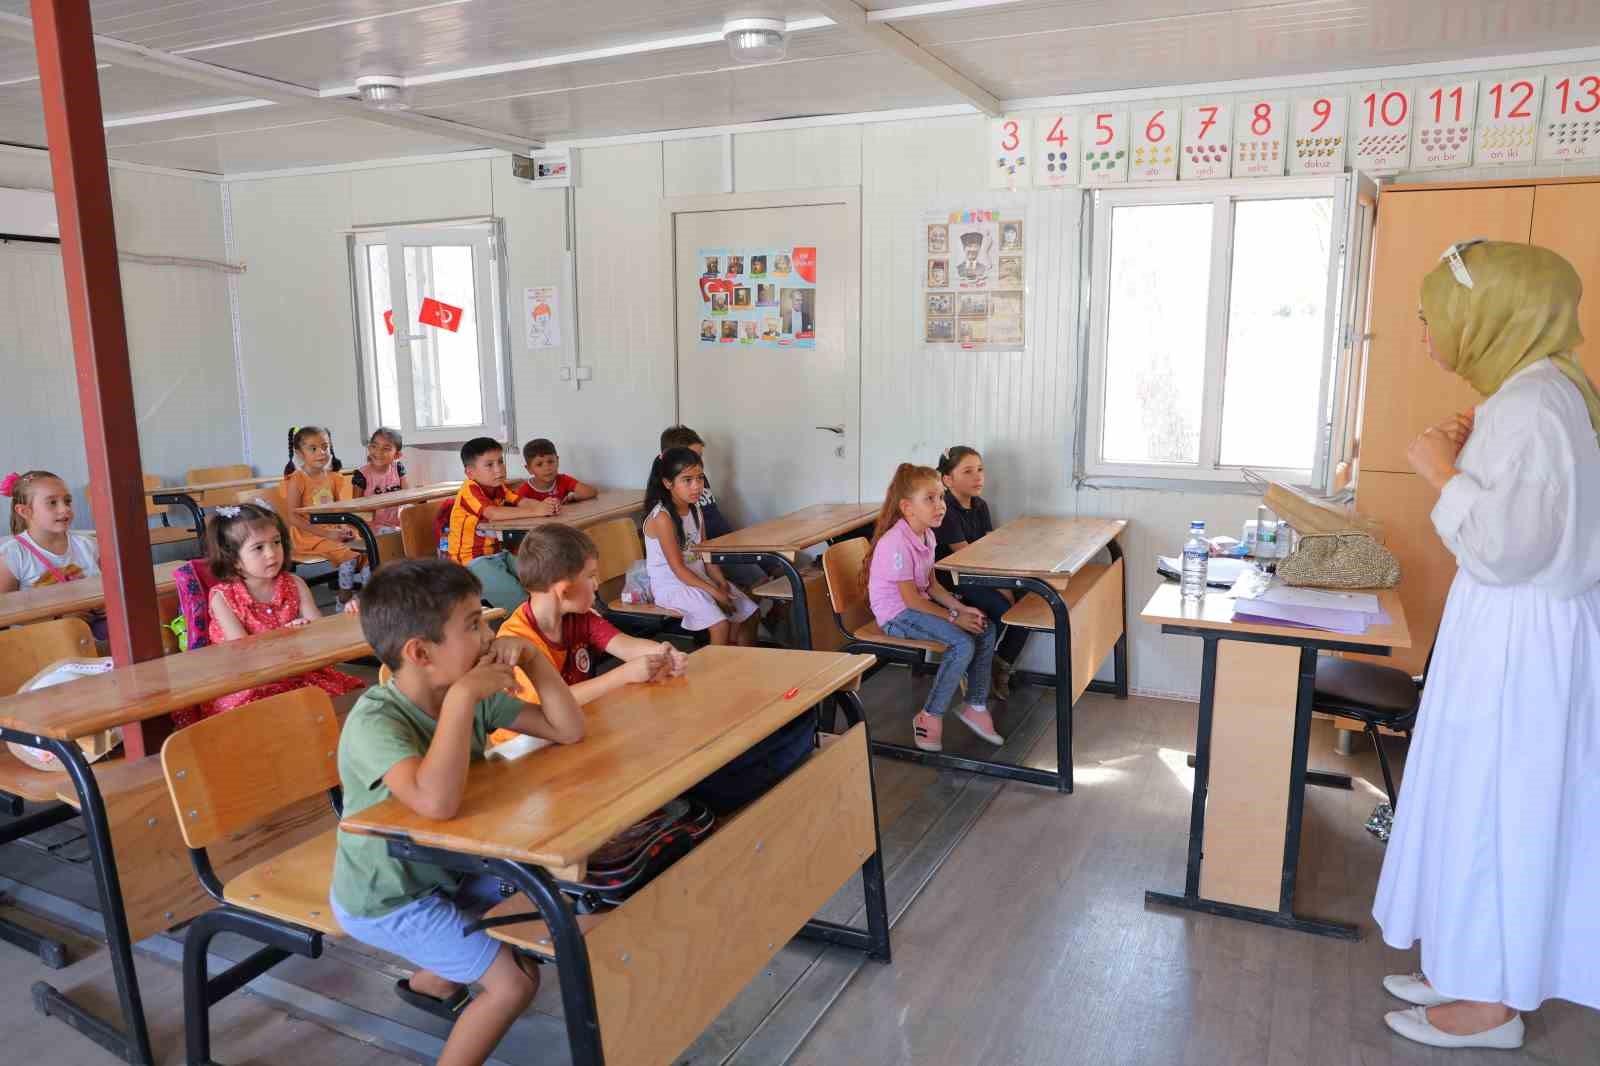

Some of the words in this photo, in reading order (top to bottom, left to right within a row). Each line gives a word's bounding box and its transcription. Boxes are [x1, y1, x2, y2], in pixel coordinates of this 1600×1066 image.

[1363, 91, 1408, 128] 10
[1429, 86, 1463, 123] 11
[1489, 81, 1535, 119] 12
[1555, 75, 1600, 115] 13
[1046, 117, 1068, 147] 4
[1095, 113, 1114, 145] 5
[1145, 110, 1165, 143] 6
[1197, 107, 1218, 140] 7
[1251, 103, 1272, 136] 8
[1311, 98, 1332, 133] 9
[1001, 120, 1020, 151] 3
[1304, 159, 1331, 169] dokuz
[1443, 152, 1457, 162] bir
[1490, 151, 1504, 159] on
